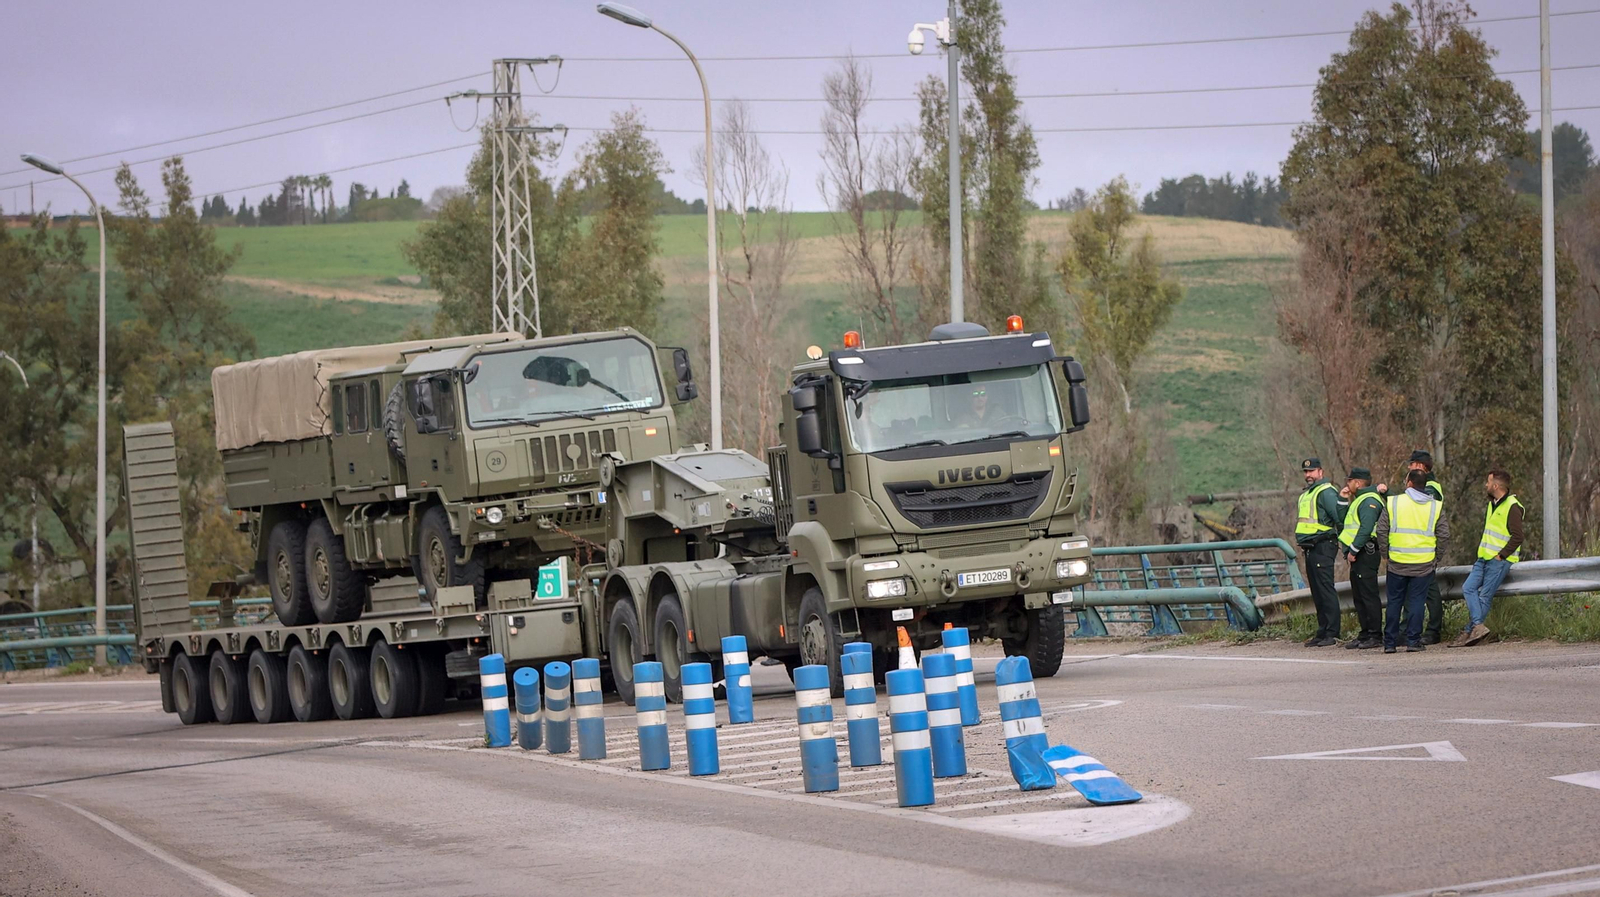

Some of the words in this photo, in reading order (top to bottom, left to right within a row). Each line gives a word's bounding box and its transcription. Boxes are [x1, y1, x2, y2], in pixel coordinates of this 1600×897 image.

[491, 457, 501, 466] 29
[938, 464, 1002, 484] IVECO
[542, 572, 555, 580] km
[966, 571, 1008, 584] ET120289
[544, 581, 554, 595] 0
